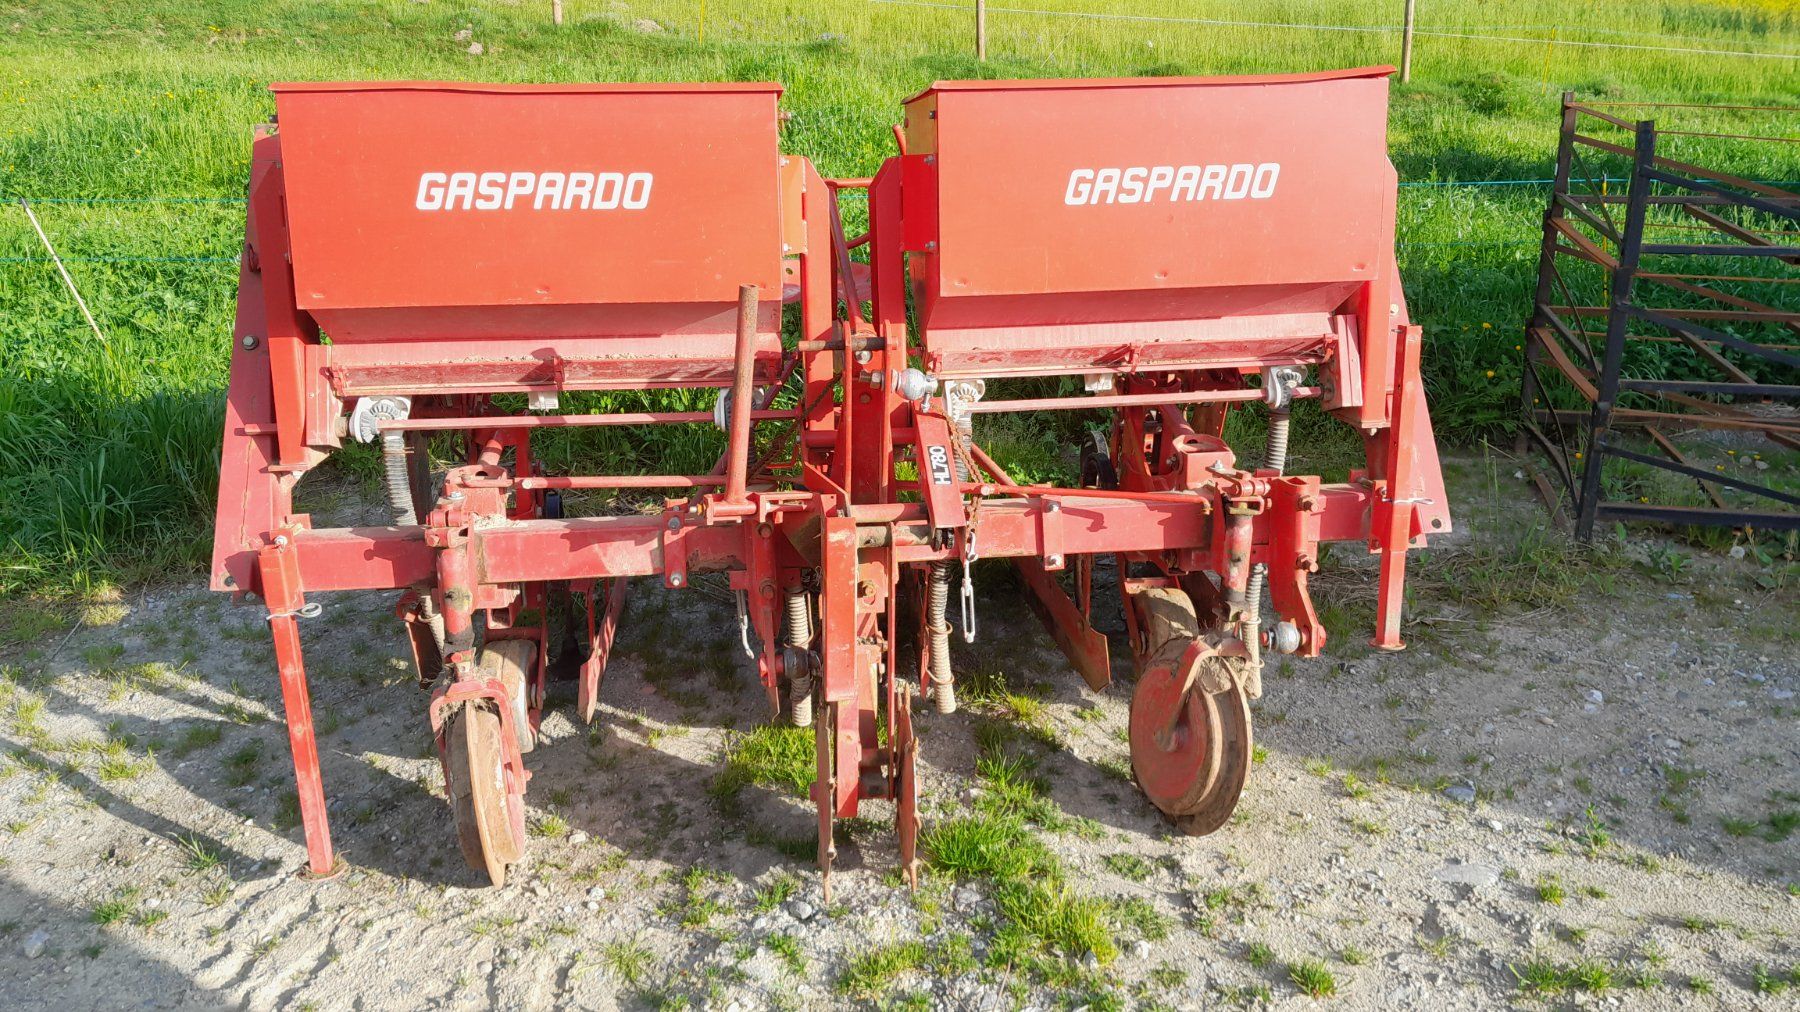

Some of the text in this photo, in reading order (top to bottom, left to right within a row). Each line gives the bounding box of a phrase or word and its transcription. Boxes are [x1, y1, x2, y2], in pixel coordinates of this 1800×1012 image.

[415, 171, 653, 210] GASPARDO
[1064, 162, 1280, 205] GASPARDO
[929, 446, 951, 484] HL780
